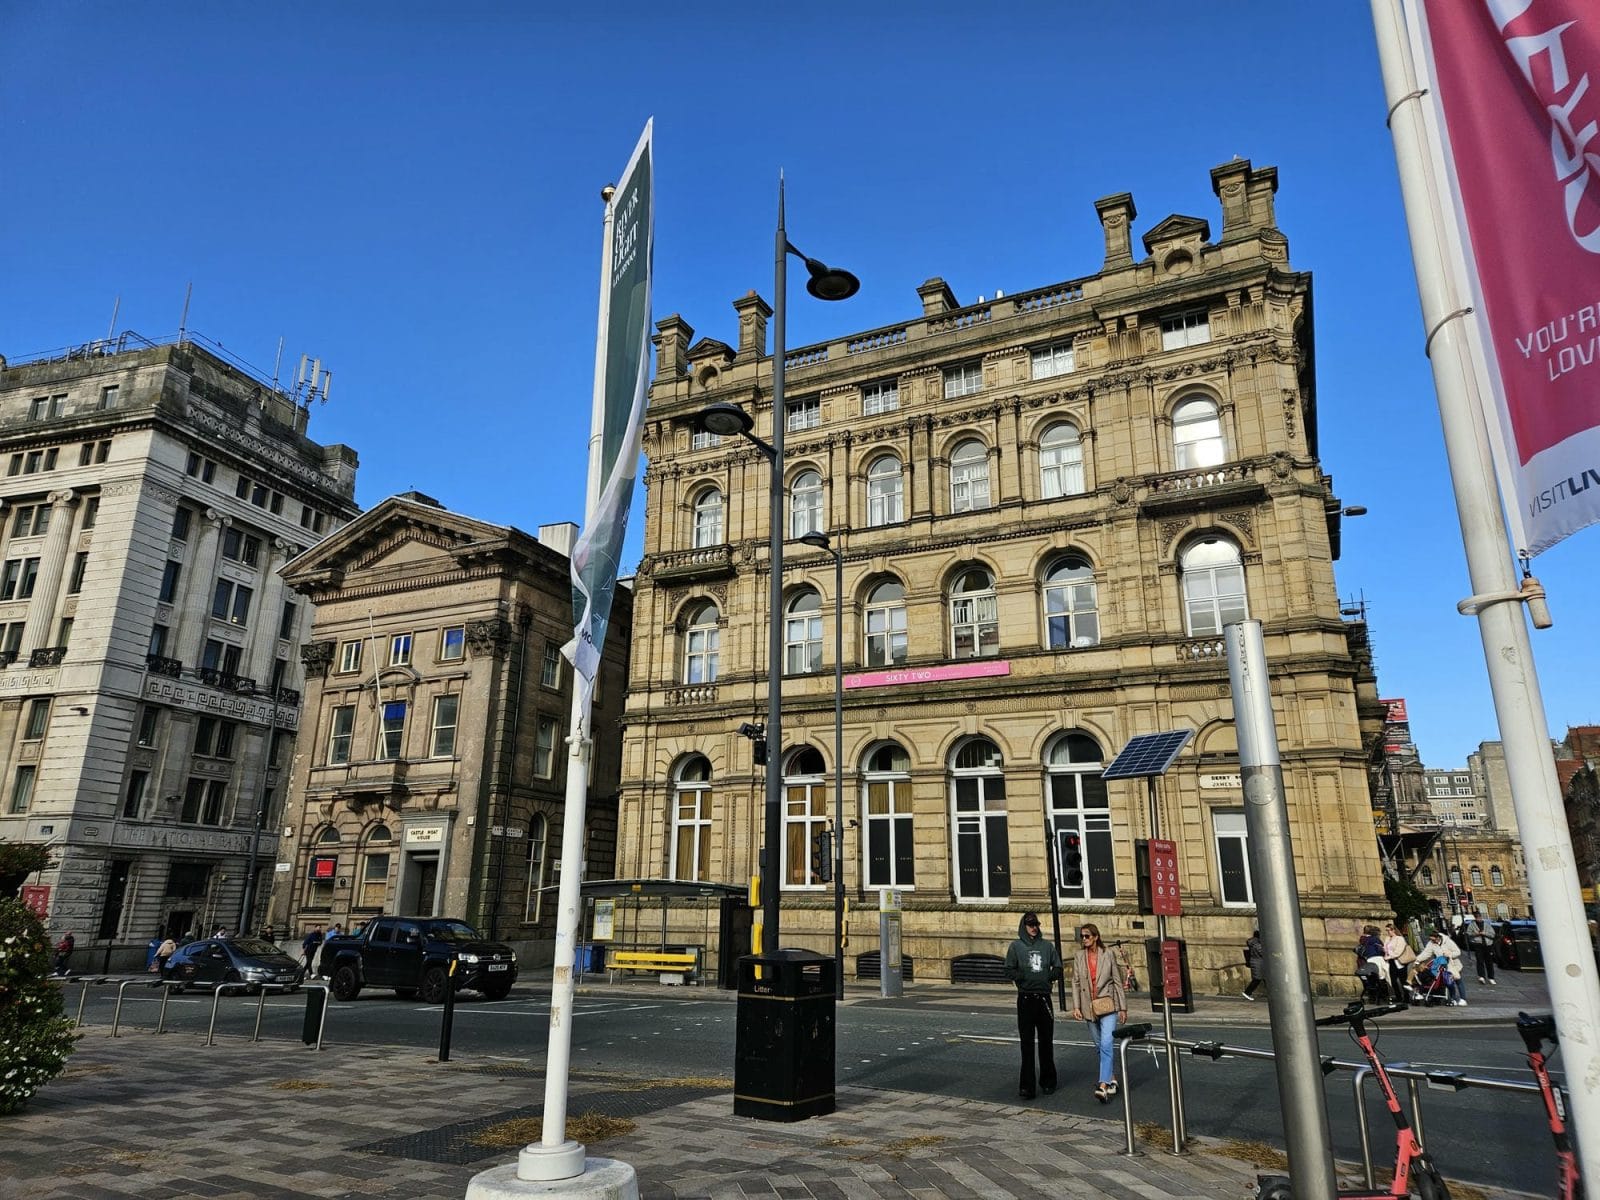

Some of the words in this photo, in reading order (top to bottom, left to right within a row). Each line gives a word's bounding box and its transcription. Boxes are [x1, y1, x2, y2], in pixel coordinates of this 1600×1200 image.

[1515, 302, 1600, 359] YOU'R
[885, 673, 909, 682] SIXTY
[911, 671, 931, 680] TWO
[754, 984, 771, 993] Litter
